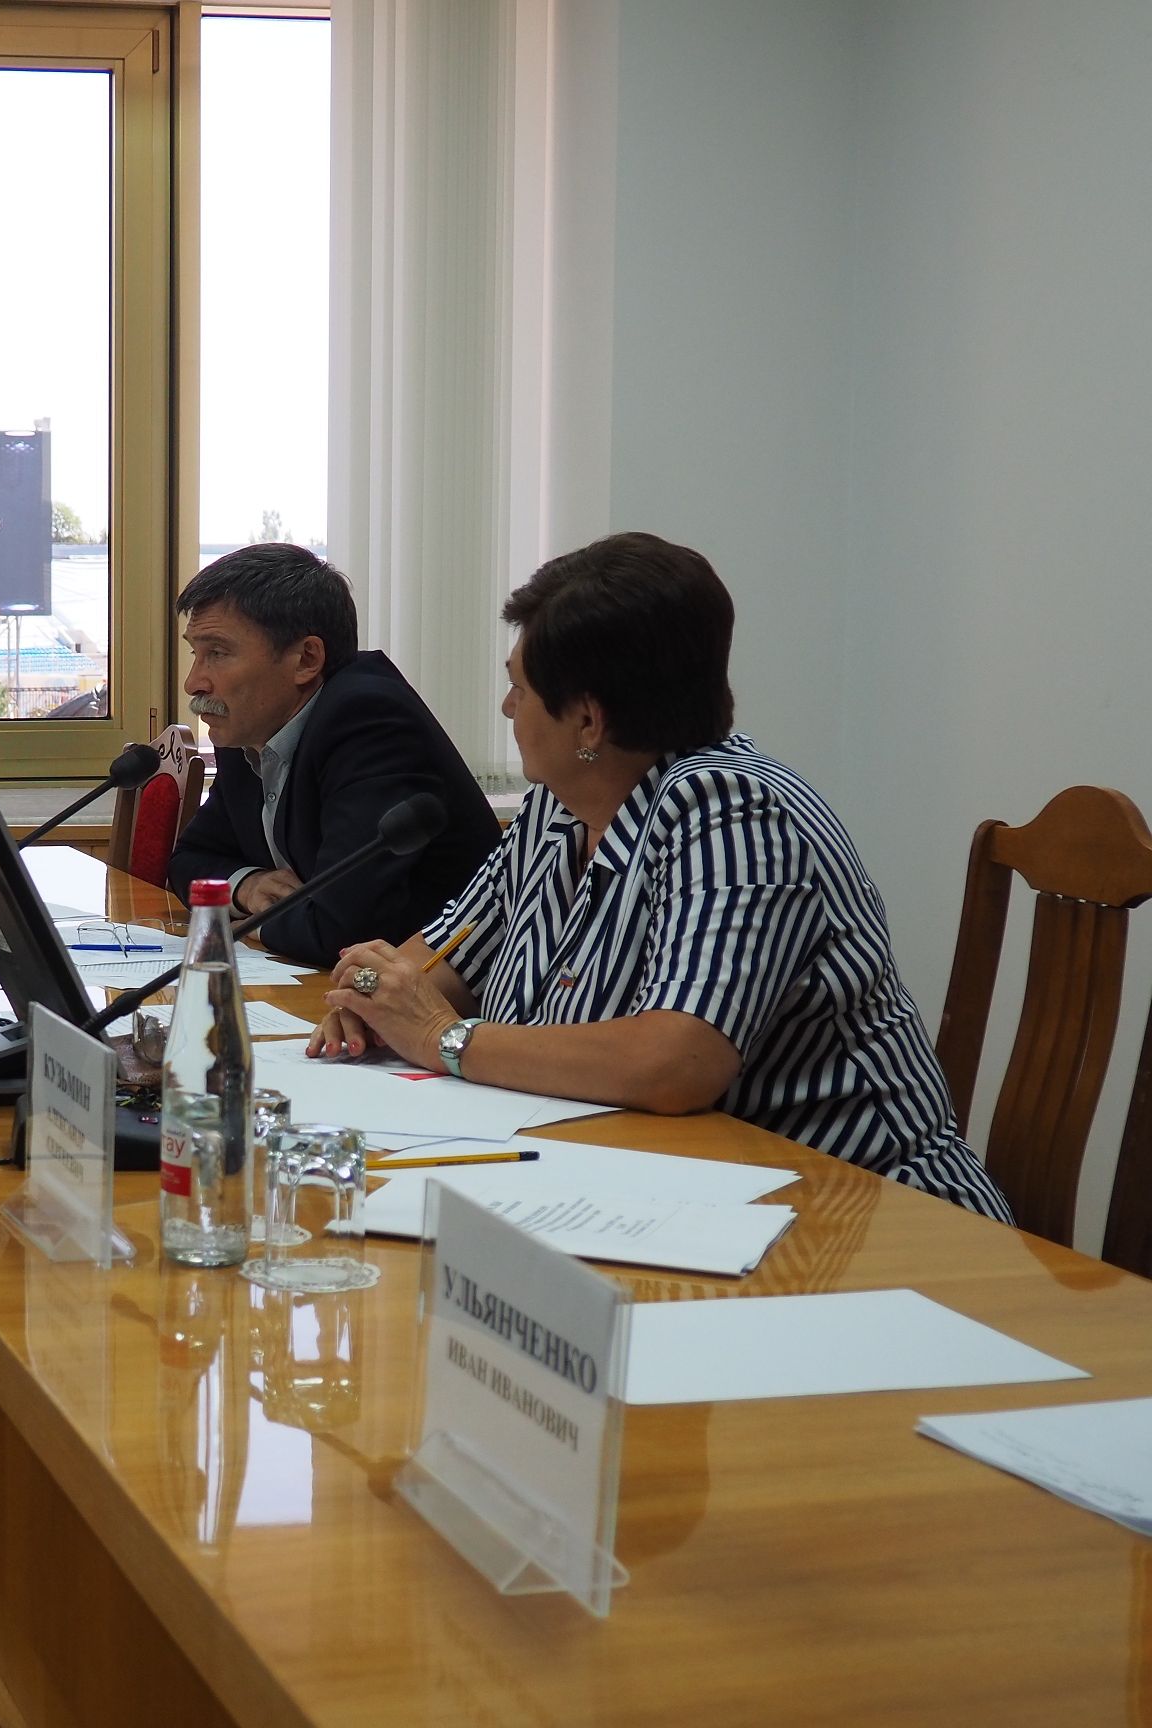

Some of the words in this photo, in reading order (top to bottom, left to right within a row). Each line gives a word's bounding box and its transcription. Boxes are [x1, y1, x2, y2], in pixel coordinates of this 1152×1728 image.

[44, 1052, 91, 1112] КУЗЬМИН
[443, 1263, 598, 1394] УЛЬЯНЧЕНКО
[448, 1337, 488, 1385] ИВАН
[490, 1366, 580, 1452] ИВАНОВИЧ
